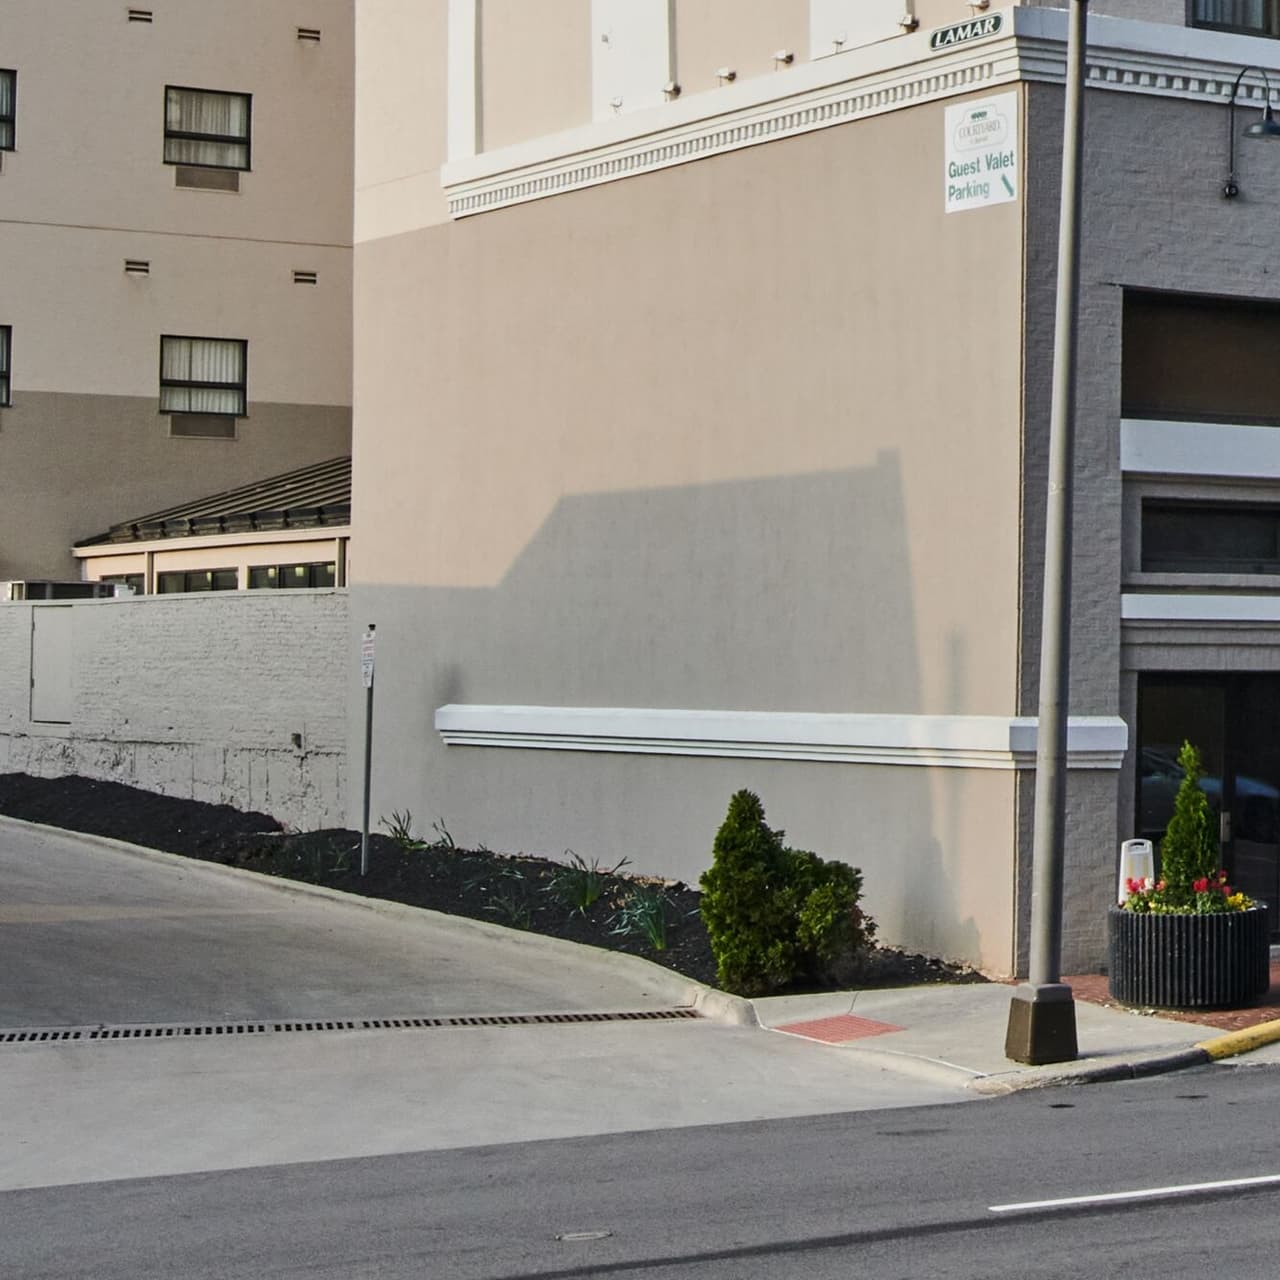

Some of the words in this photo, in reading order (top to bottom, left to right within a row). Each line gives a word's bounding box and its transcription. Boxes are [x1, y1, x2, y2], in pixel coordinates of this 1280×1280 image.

[934, 16, 996, 48] LAMAR
[948, 157, 980, 179] Guest
[985, 150, 1015, 171] Valet
[948, 181, 990, 201] Parking
